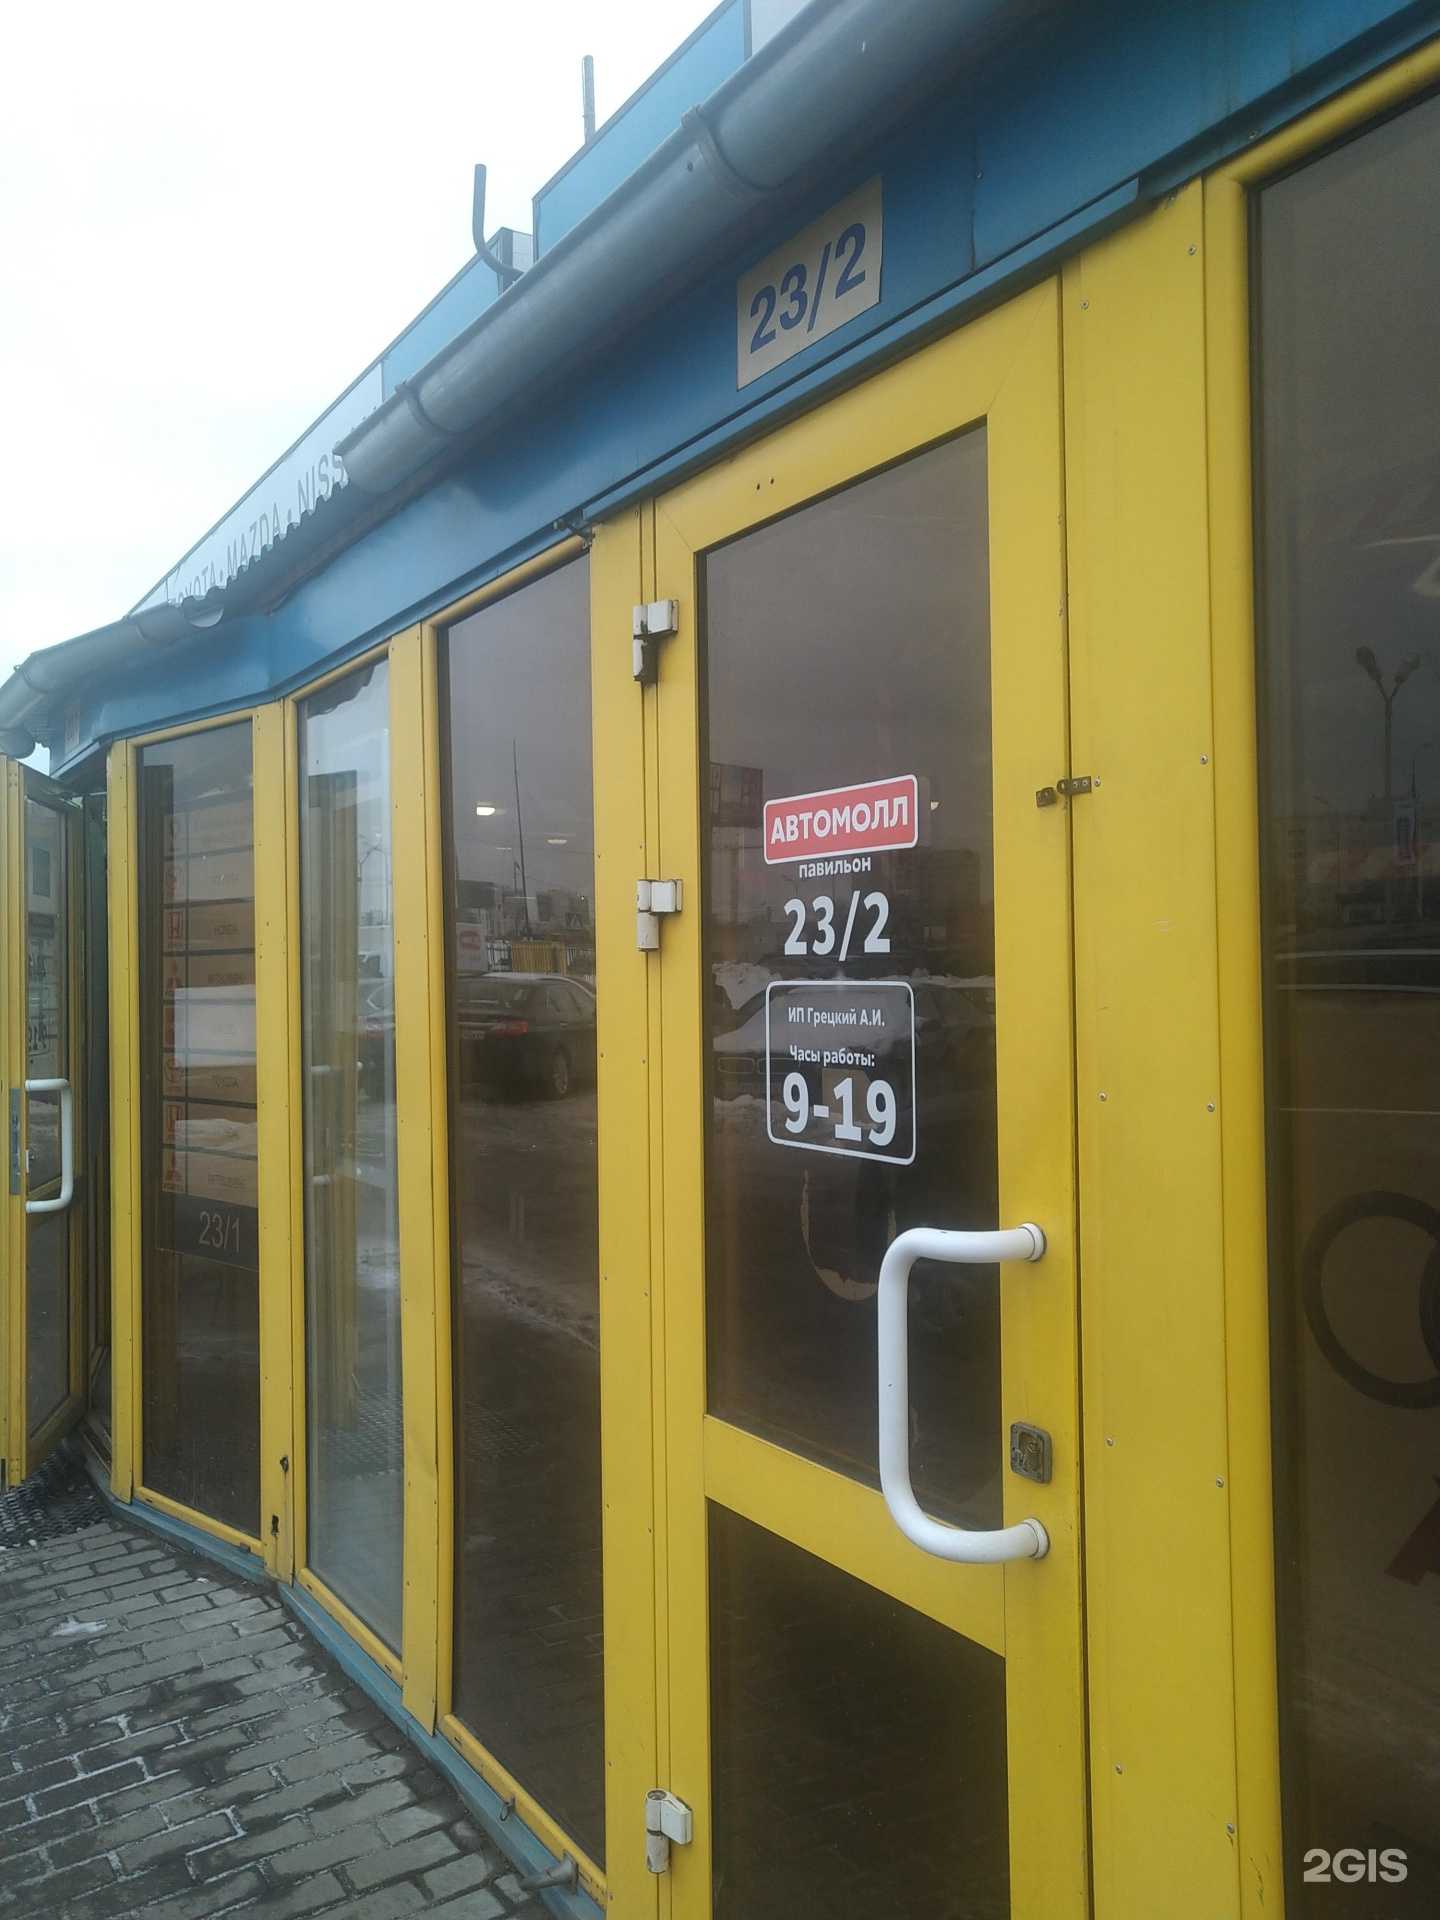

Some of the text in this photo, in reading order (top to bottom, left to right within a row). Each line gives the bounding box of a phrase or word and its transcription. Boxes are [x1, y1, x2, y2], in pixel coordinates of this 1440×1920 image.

[750, 222, 865, 354] 23/2
[169, 559, 217, 605] OYOTA
[770, 796, 908, 845] АВТОМОЛЛ
[799, 856, 872, 879] павильон
[784, 890, 891, 962] 23/2
[788, 1007, 886, 1027] ИП Грецкий А.И.
[789, 1045, 876, 1067] Часы работы:
[783, 1072, 897, 1147] 9-19
[199, 1210, 240, 1253] 23/1
